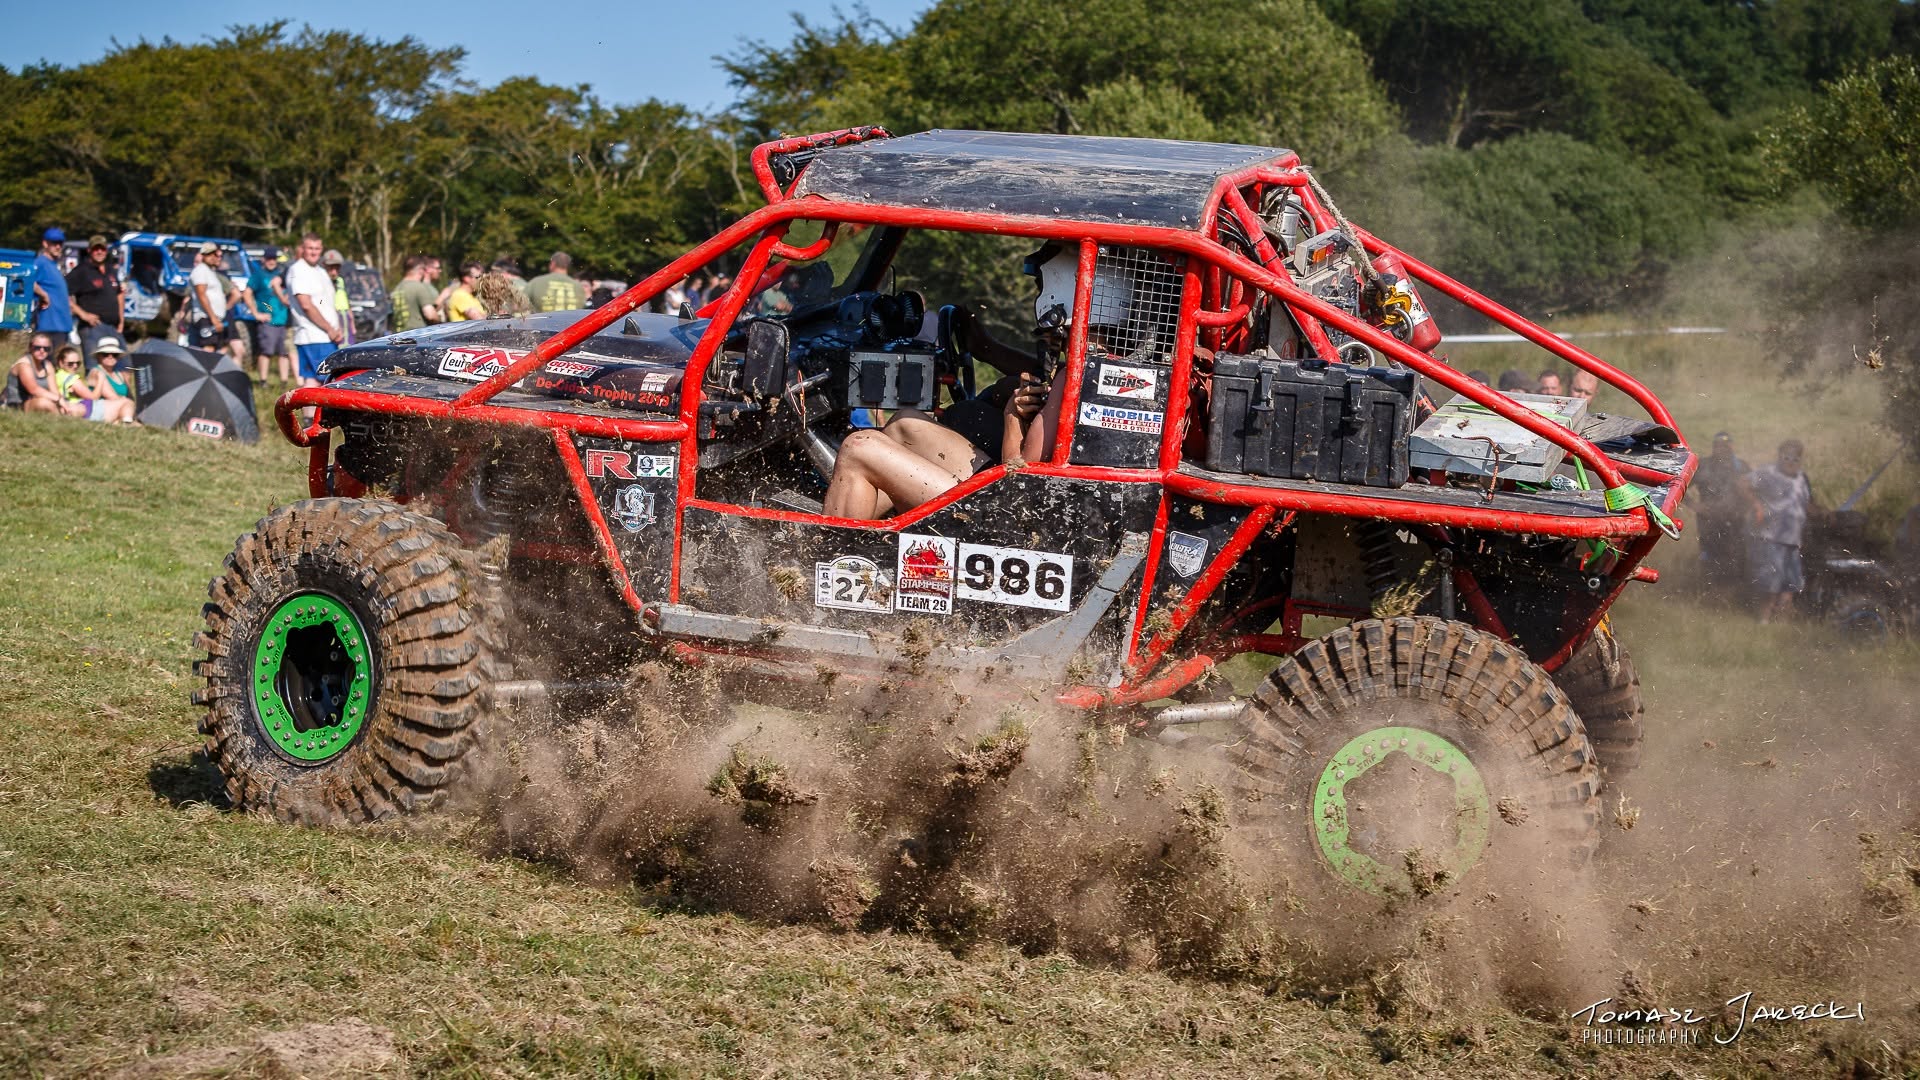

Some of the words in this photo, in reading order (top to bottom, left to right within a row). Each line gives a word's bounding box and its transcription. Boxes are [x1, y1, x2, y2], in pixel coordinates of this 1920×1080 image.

[549, 360, 598, 372] ODYSSEY
[1102, 374, 1146, 390] SIGNS
[592, 385, 636, 402] Trophy
[1102, 408, 1162, 422] MOBILE
[192, 422, 220, 435] ARB
[1101, 422, 1128, 430] 07813
[964, 553, 1066, 601] 986
[834, 577, 871, 604] 27
[899, 595, 930, 610] TEAM
[932, 599, 948, 612] 29
